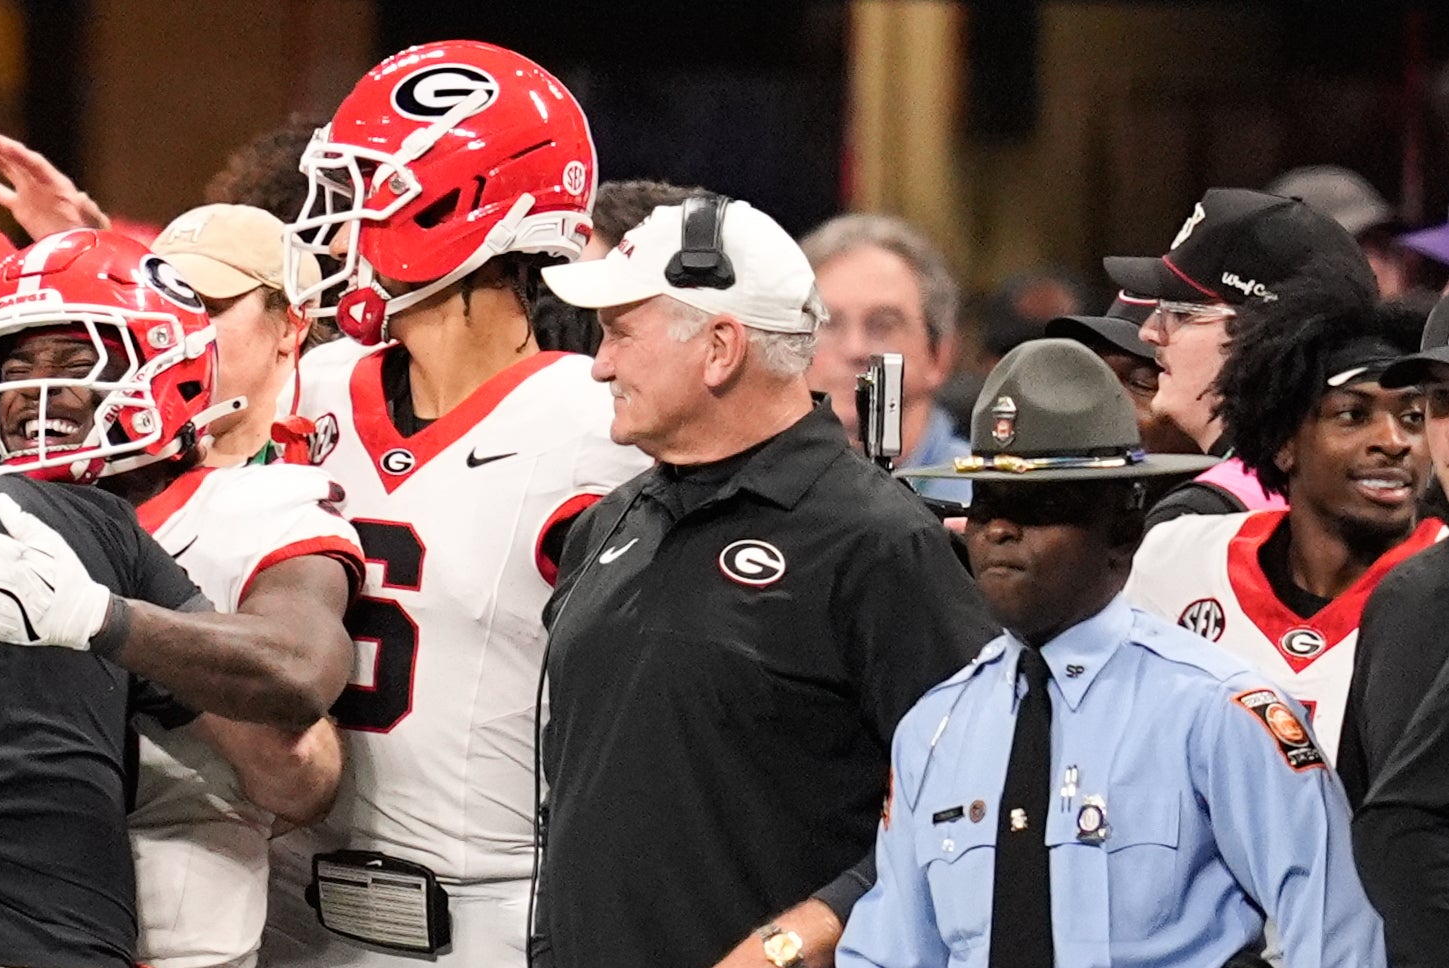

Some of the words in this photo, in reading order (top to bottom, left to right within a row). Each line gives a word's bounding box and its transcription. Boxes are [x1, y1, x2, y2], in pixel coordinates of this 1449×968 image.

[566, 163, 584, 194] SEC
[382, 450, 414, 473] G
[722, 542, 782, 581] G
[1281, 628, 1325, 655] G
[1065, 664, 1085, 679] SP
